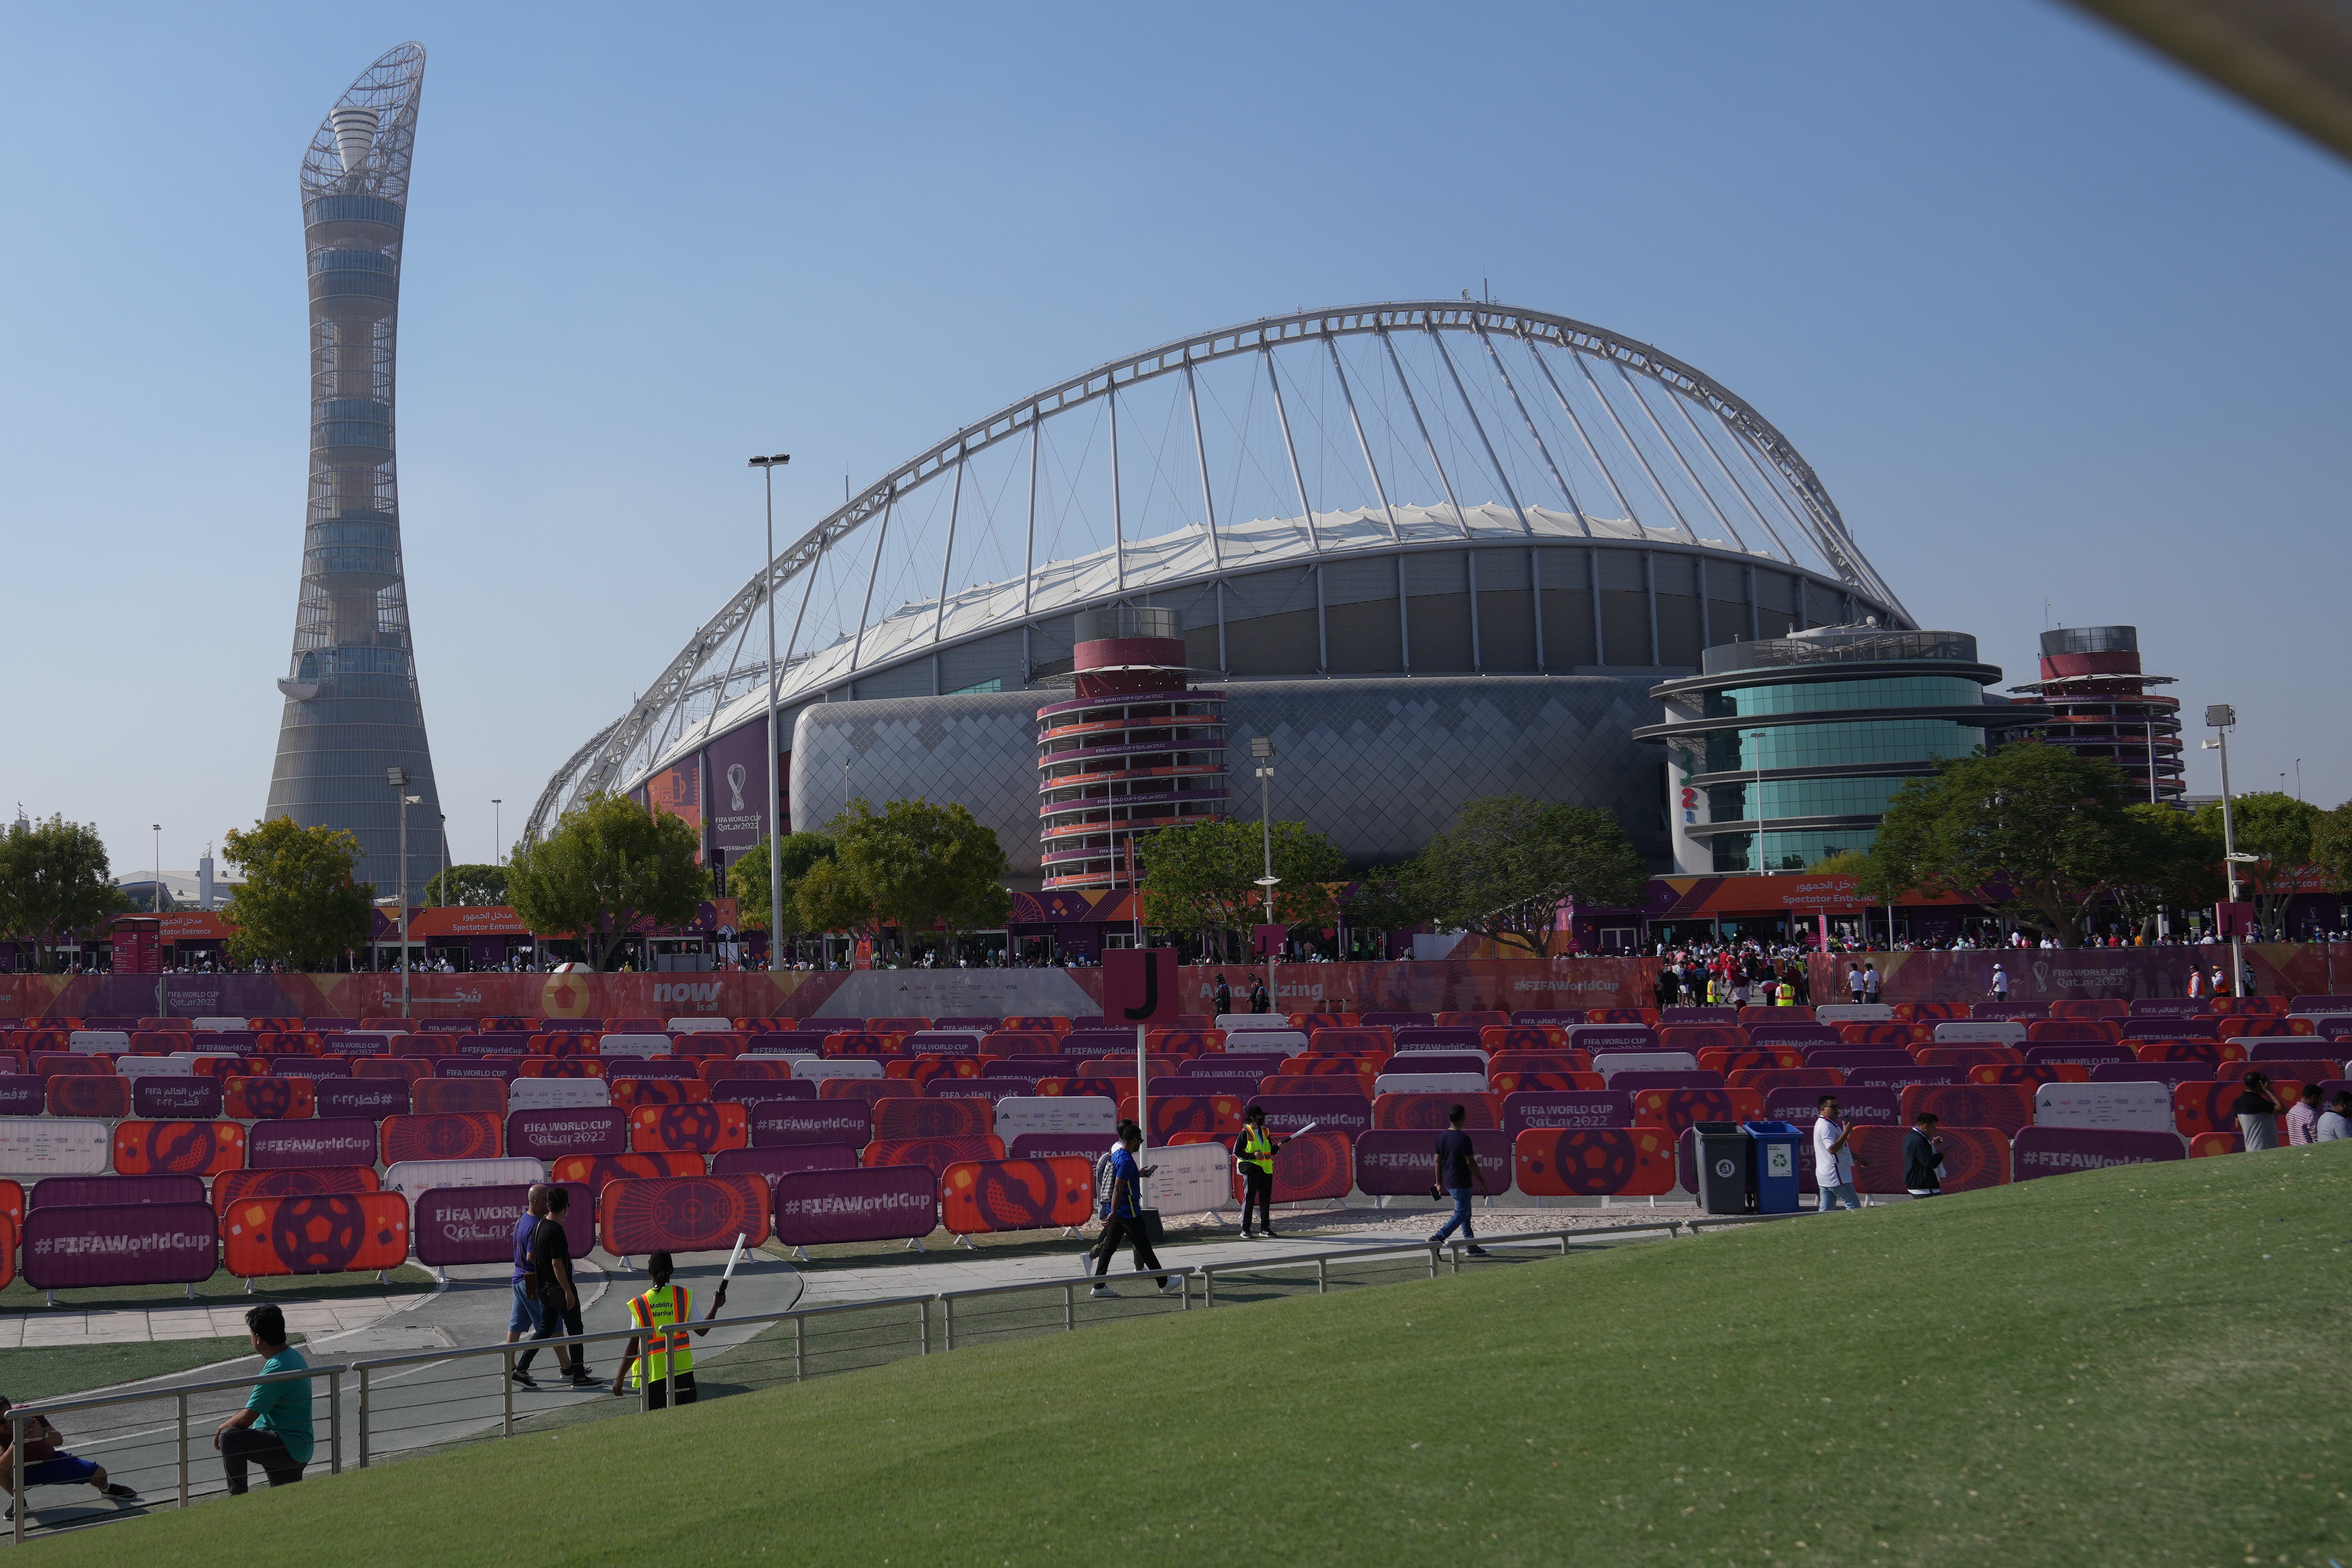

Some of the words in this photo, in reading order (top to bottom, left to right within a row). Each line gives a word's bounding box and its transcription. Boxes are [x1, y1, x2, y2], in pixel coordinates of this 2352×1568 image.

[1682, 788, 1695, 807] 2
[1782, 895, 1832, 905] Spectator
[183, 917, 202, 926] مدخل
[463, 912, 490, 921] الجمهور
[491, 911, 512, 921] مدخل
[453, 924, 488, 932] Spectator
[2245, 921, 2253, 934] 1
[1256, 935, 1267, 954] J
[1278, 943, 1286, 954] 1
[1124, 952, 1158, 1020] J
[1514, 980, 1619, 993] #FIFAWorldCup
[2057, 977, 2124, 989] Qatar2022
[654, 982, 721, 1002] now
[170, 998, 216, 1007] Qatar2022
[697, 1002, 705, 1011] is
[706, 1002, 718, 1011] all
[164, 1087, 187, 1097] العالم
[190, 1087, 209, 1096] كأس
[1521, 1105, 1544, 1115] FIFA
[1548, 1105, 1589, 1115] WORLD
[1591, 1105, 1613, 1114] CUP
[1774, 1105, 1891, 1120] #FIFAorldCup
[524, 1122, 546, 1133] FIFA
[549, 1121, 589, 1131] WORLD
[591, 1120, 612, 1130] CUP
[757, 1117, 865, 1131] #FIFAWorldCup
[1265, 1113, 1365, 1127] FIFAWorldCup
[1526, 1115, 1608, 1128] Qatar2022
[255, 1137, 371, 1152] #FIFAWorldCup
[528, 1131, 606, 1147] Qatar2022
[1364, 1153, 1503, 1171] #FIFAWCup
[786, 1192, 930, 1215] #FIFAWorldCup
[436, 1208, 471, 1222] FIFA
[443, 1223, 516, 1243] Qatar
[34, 1232, 211, 1254] #FIFAWorldCup
